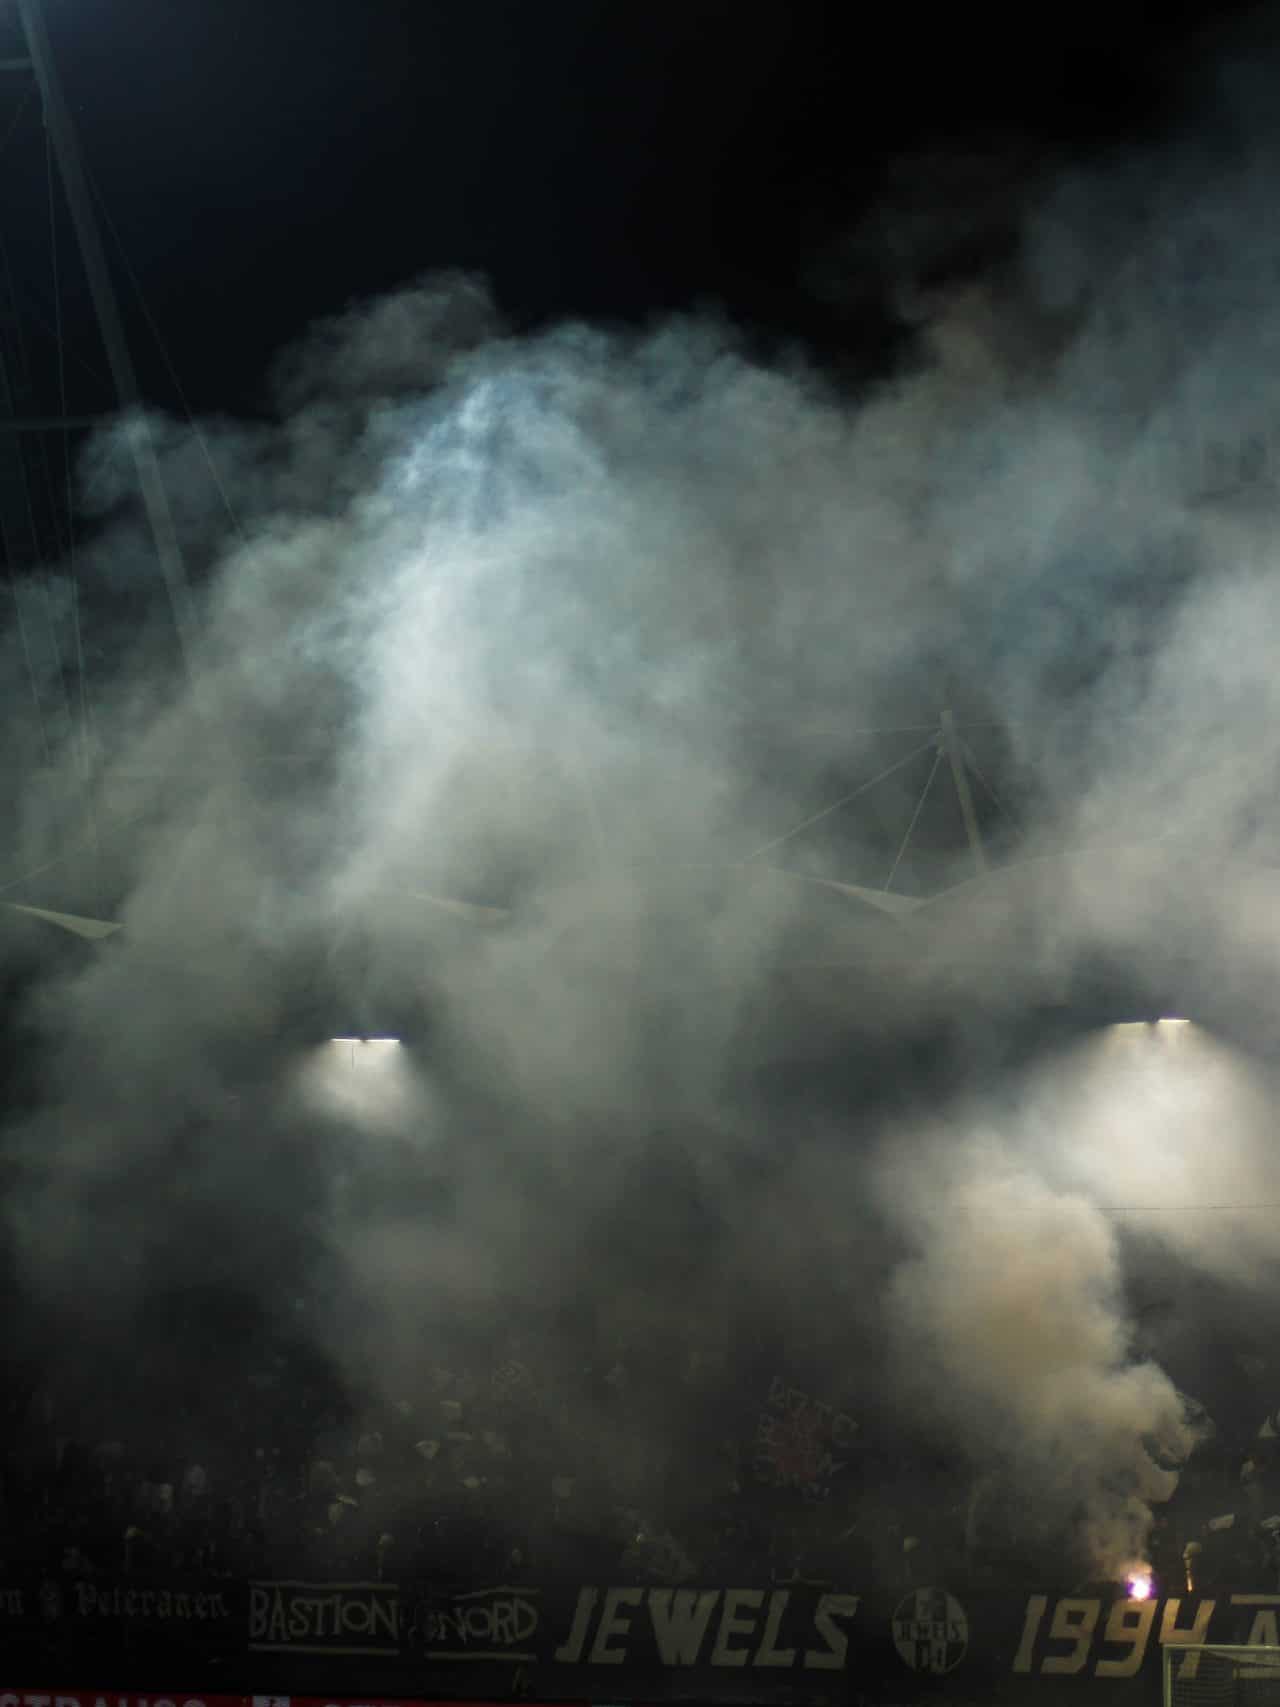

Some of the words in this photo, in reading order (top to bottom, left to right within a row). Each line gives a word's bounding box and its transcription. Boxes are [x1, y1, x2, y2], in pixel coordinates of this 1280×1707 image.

[249, 1585, 400, 1641] BASTION
[552, 1586, 863, 1670] JEWELS
[1011, 1595, 1217, 1680] 1994
